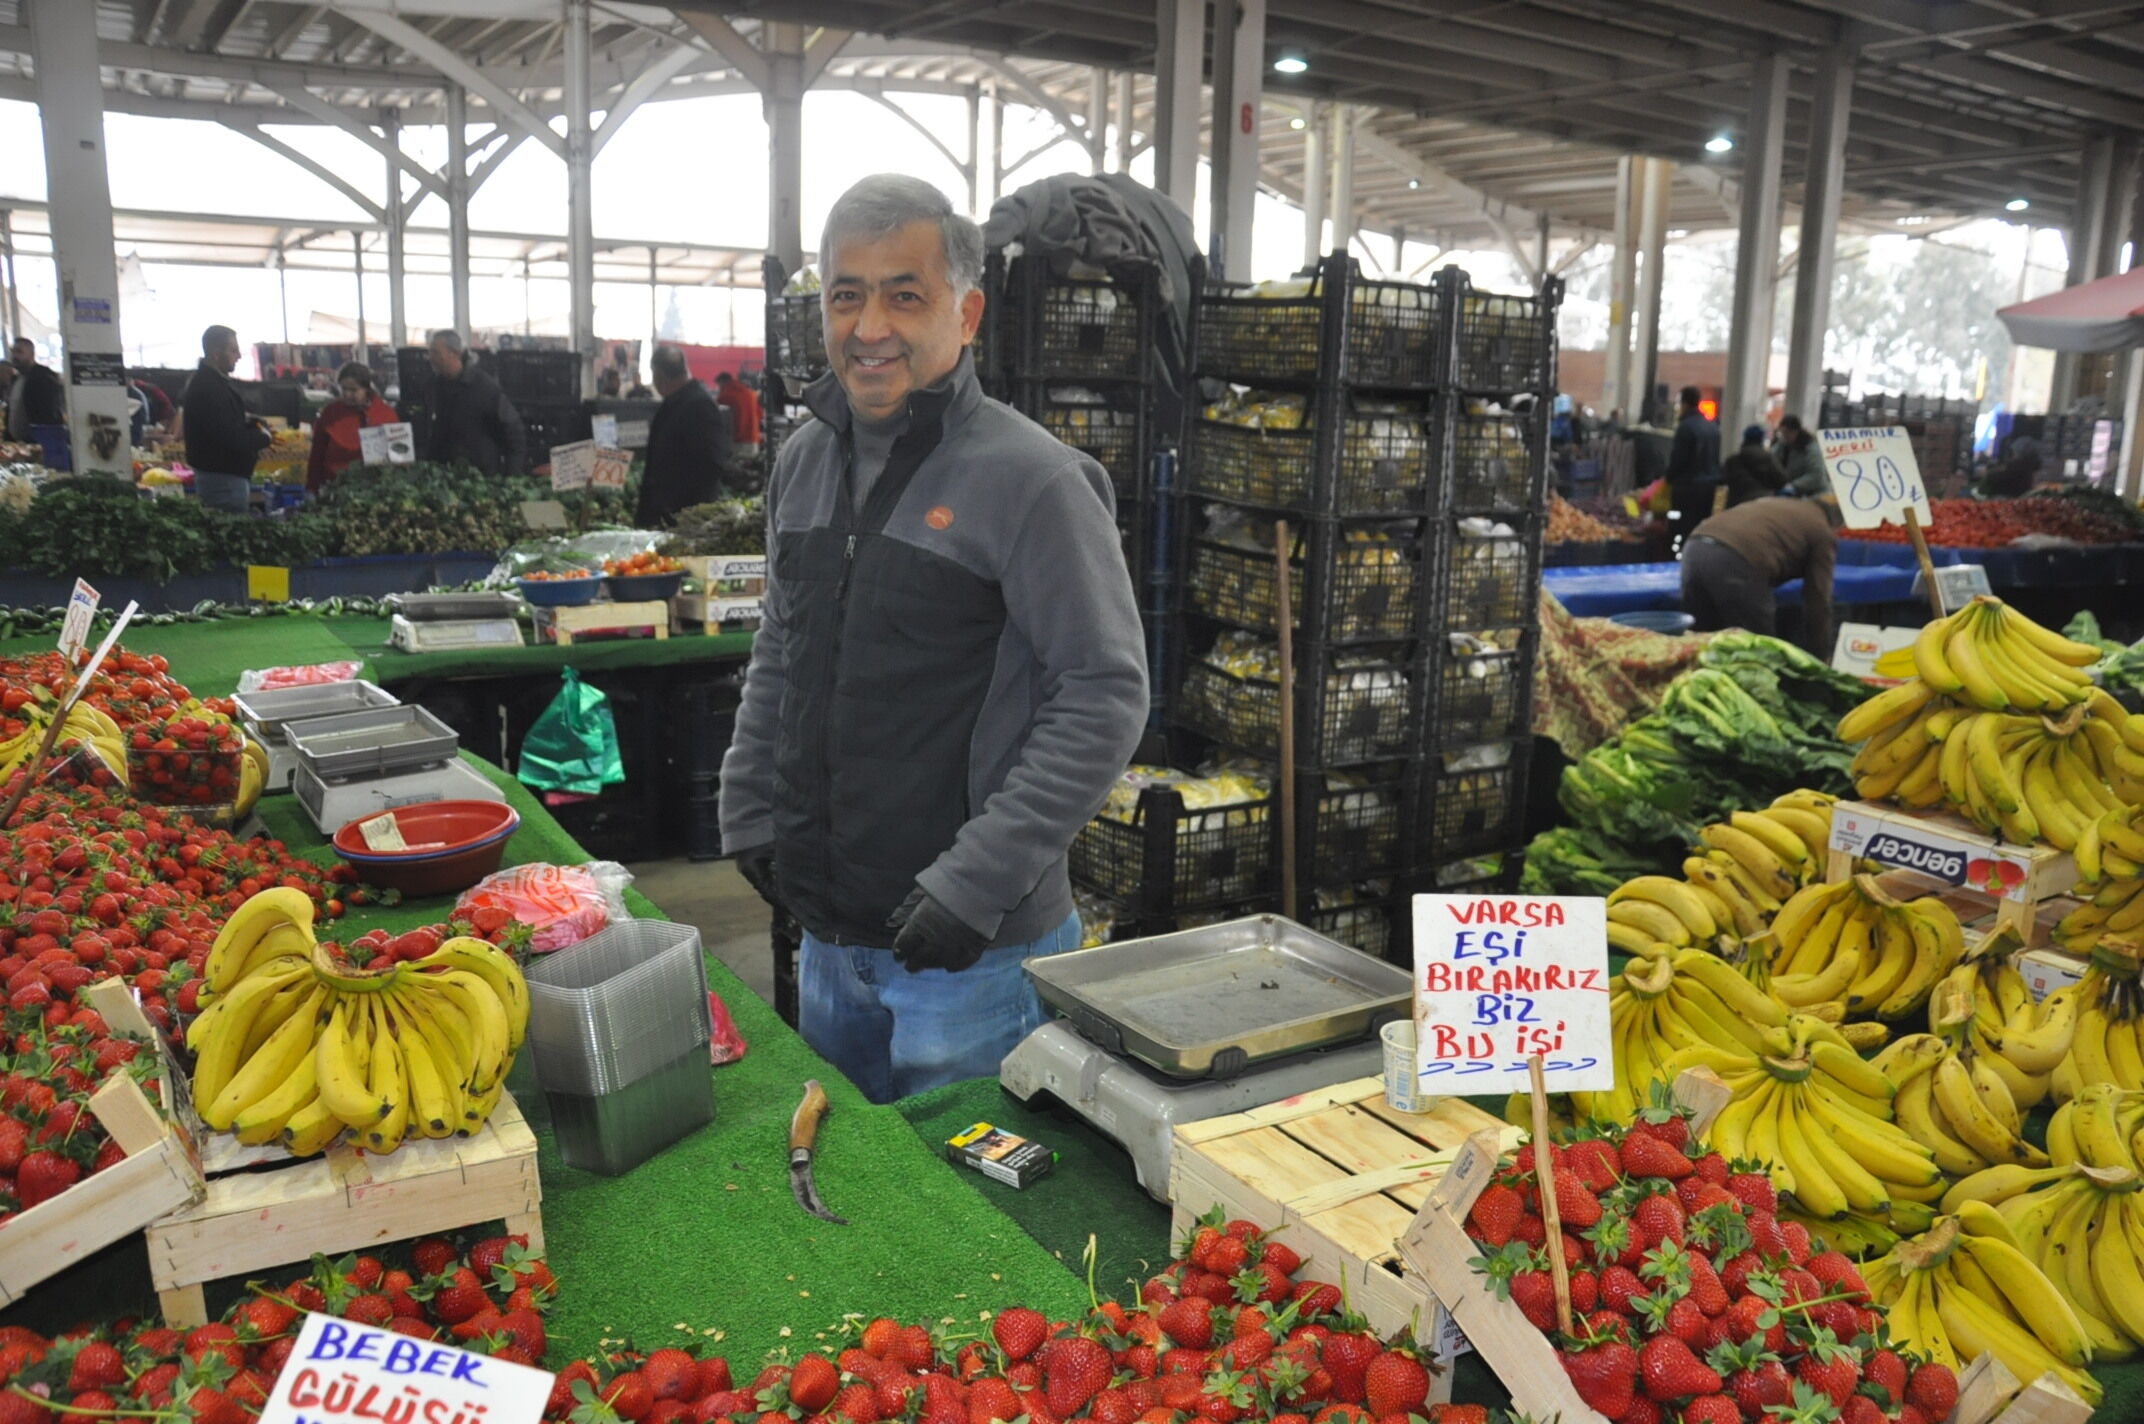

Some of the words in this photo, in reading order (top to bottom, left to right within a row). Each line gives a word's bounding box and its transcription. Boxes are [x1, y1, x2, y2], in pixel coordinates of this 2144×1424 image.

[1241, 103, 1253, 134] 6
[1836, 455, 1904, 512] 80
[1870, 835, 1963, 878] gencer
[1446, 899, 1565, 928] VARSA
[1423, 962, 1610, 995] BIRAKIRIZ
[1431, 1024, 1495, 1060] BU
[305, 1321, 489, 1388] BEBEK
